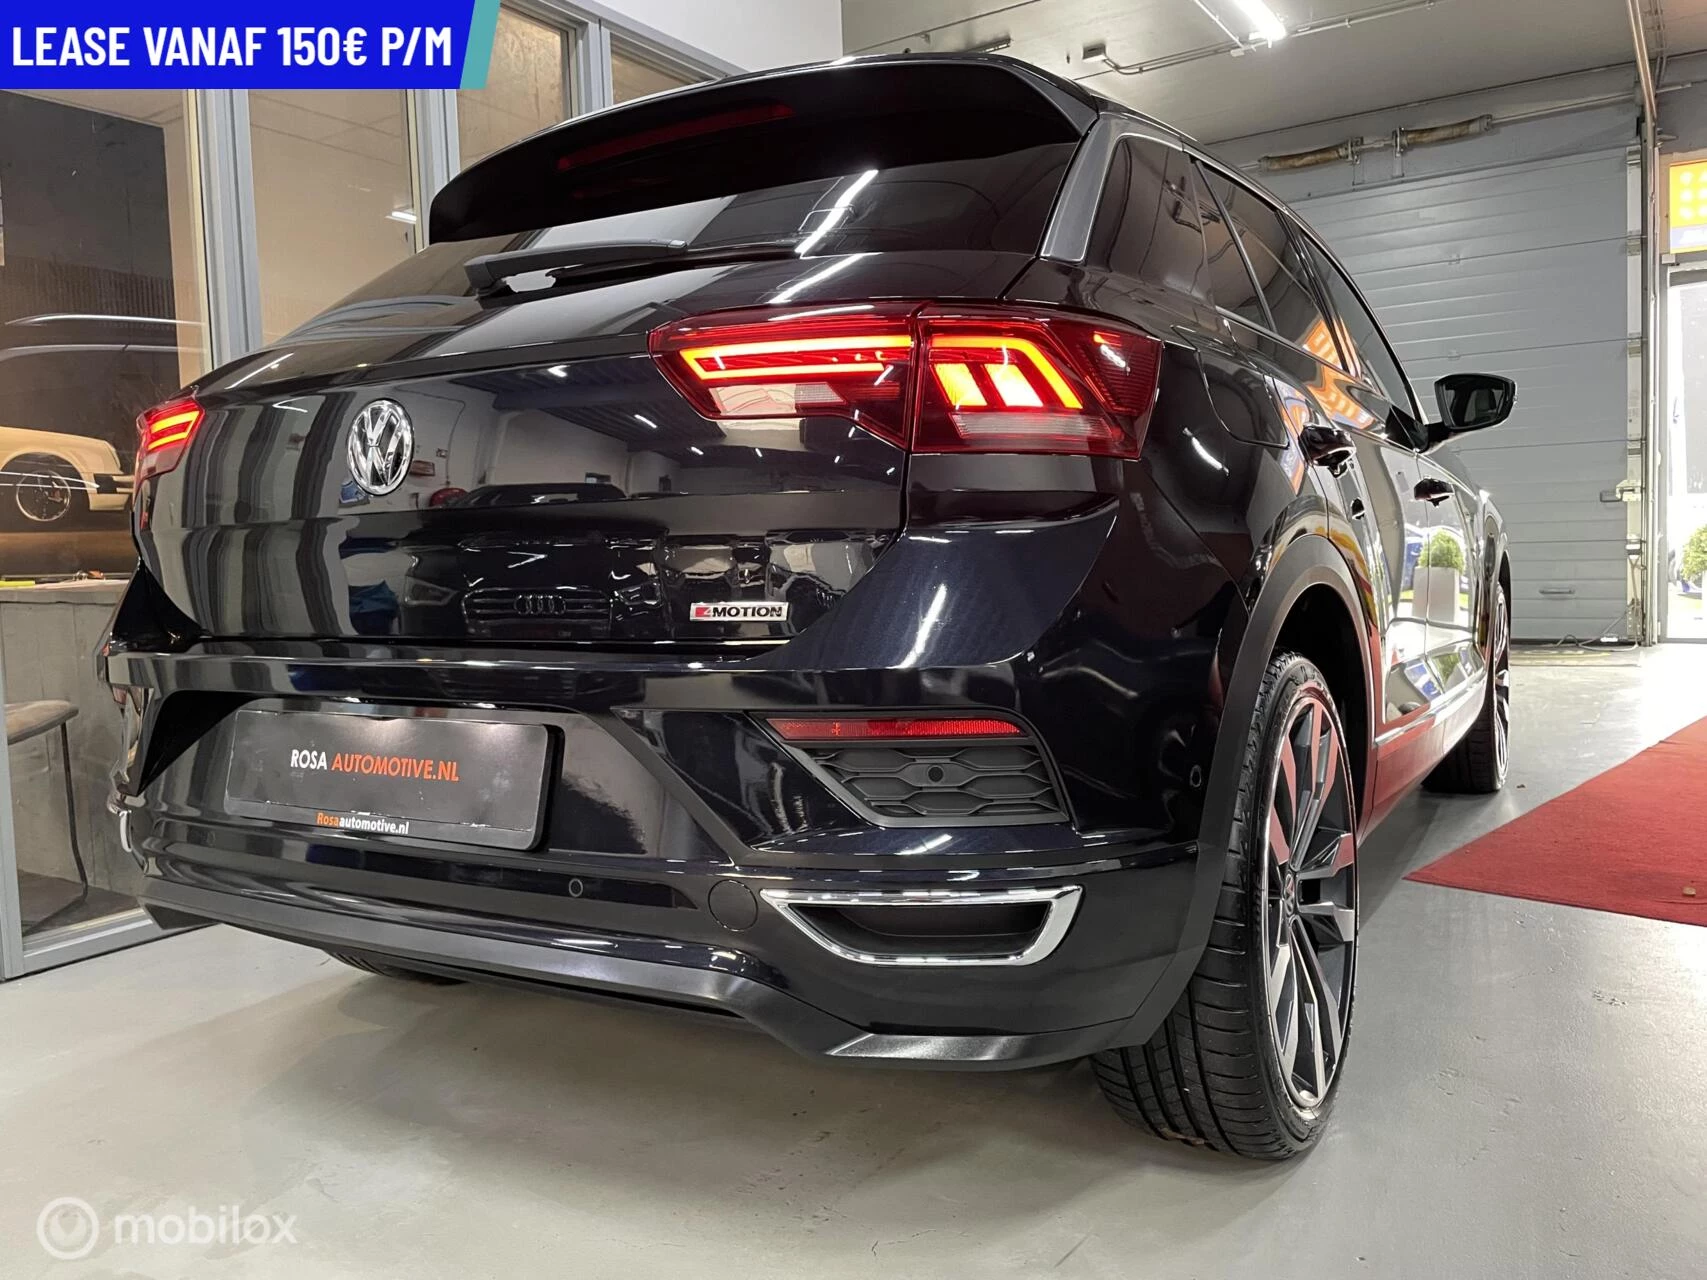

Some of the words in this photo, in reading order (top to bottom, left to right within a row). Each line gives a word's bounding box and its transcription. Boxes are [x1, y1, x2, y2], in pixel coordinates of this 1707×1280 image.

[290, 749, 328, 770] ROSA
[331, 752, 459, 782] AUTOMOTIVE.NL
[316, 812, 410, 834] Rosaautomotive.nl
